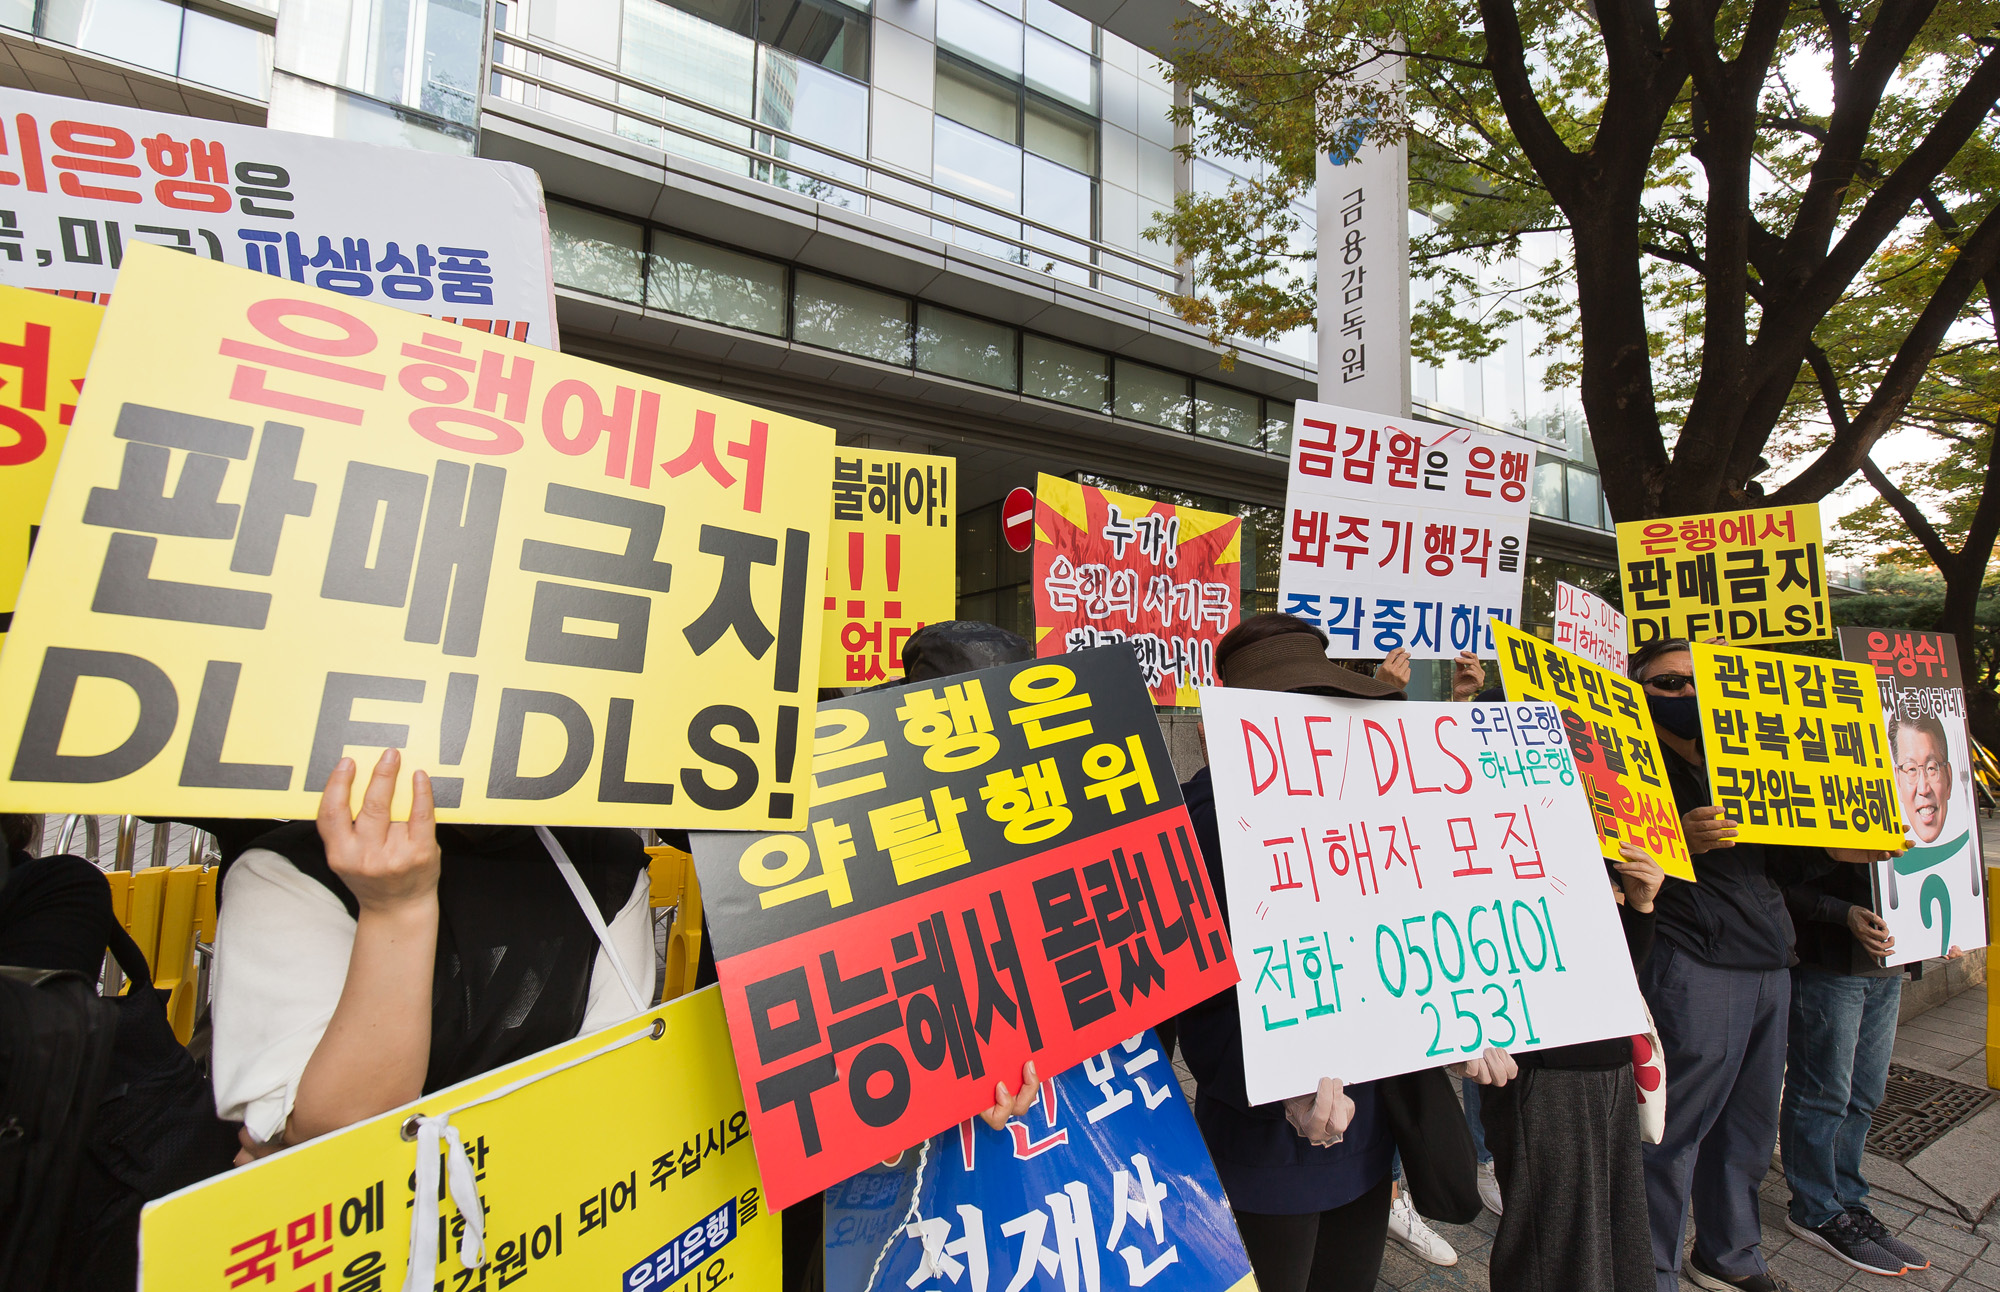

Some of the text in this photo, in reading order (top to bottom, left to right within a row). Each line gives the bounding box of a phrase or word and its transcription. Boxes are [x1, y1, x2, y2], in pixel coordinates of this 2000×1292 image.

[237, 228, 494, 305] 파생상품
[1340, 187, 1366, 384] 금융감독원
[218, 298, 769, 513] 은행에서
[832, 457, 947, 528] 불해야!
[1299, 418, 1529, 502] 금감원은 은행
[82, 402, 811, 693] 판매금지
[1103, 504, 1179, 567] 누가!
[1288, 509, 1413, 574] 봐주기
[1640, 510, 1796, 556] 은행에서
[1045, 555, 1232, 634] 은행의 사기극
[1627, 543, 1821, 611] 판매금지
[1507, 636, 1643, 730] 대한민국
[1713, 654, 1864, 714] 관리감독
[1867, 631, 1948, 678] 은성수!
[809, 664, 1094, 808] 은행은
[1470, 706, 1563, 746] 우리은행
[1712, 708, 1884, 769] 반복실패!
[1903, 686, 1967, 720] 좋아하네!
[1240, 715, 1473, 800] DLF/DLS
[1478, 747, 1575, 788] 하나은행
[738, 733, 1160, 909] 약탈행위
[1617, 784, 1688, 862] 은성수!
[1716, 766, 1901, 835] 금감위는 반성해!
[1263, 804, 1546, 902] 피해자 모집
[1375, 896, 1566, 999] 0506101
[744, 890, 1045, 1158] 무능해서
[1031, 824, 1226, 1032] 몰랐나!
[1420, 978, 1540, 1058] 2531
[224, 1180, 385, 1290] 국민에
[577, 1170, 637, 1237] 되어
